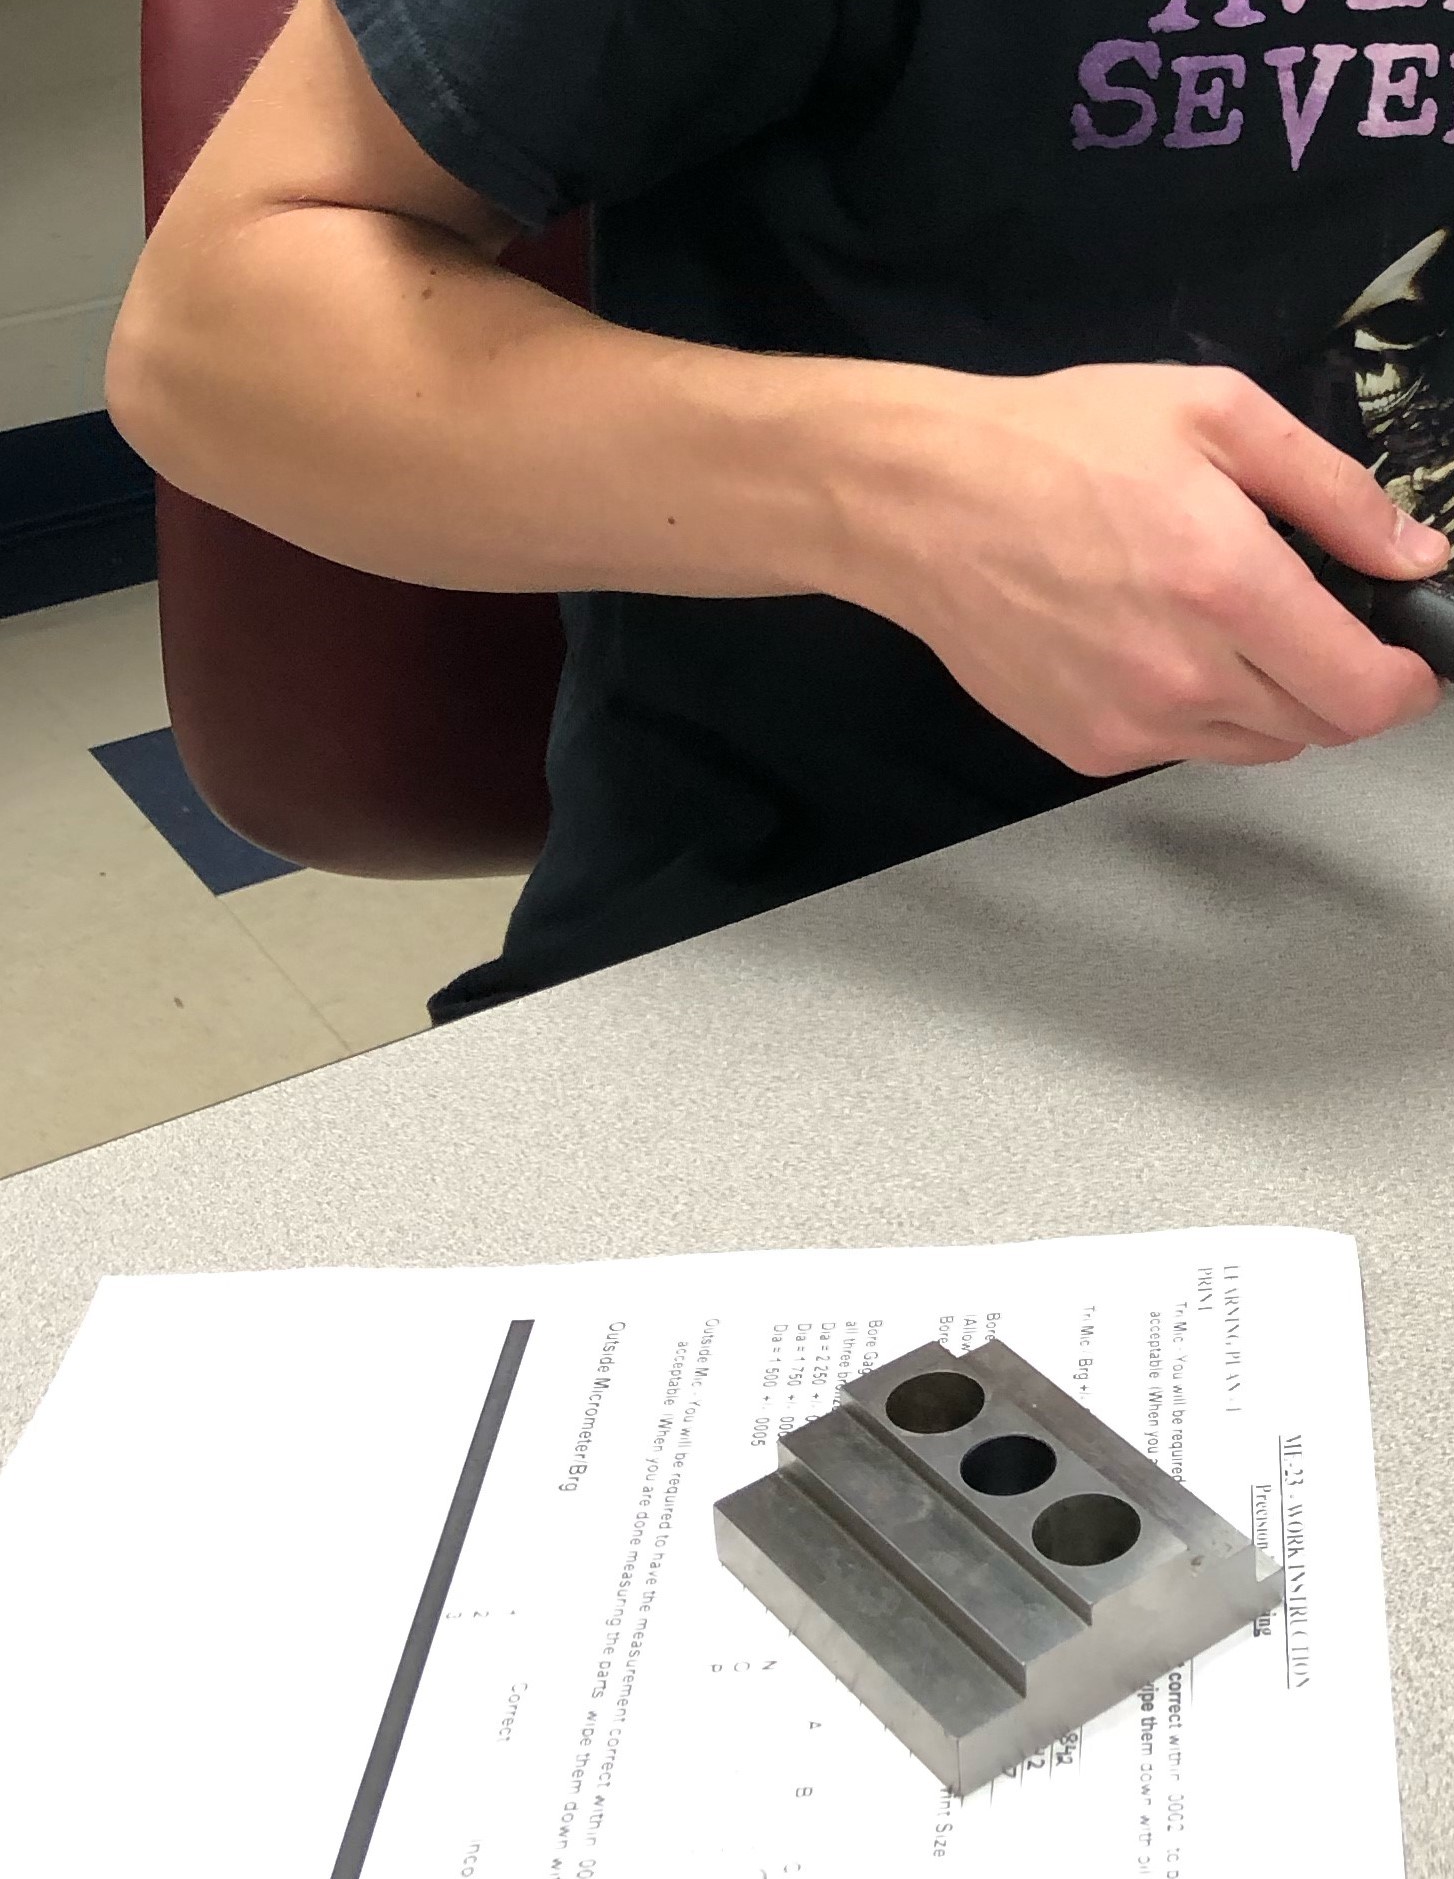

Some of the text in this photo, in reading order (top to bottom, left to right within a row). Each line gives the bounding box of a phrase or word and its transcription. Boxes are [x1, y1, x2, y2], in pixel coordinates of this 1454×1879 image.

[771, 1324, 789, 1343] Dia
[796, 1323, 813, 1342] Dia
[820, 1322, 836, 1341] Dia
[845, 1320, 860, 1334] all
[865, 1320, 883, 1347] Bore
[938, 1316, 954, 1345] Bore
[984, 1312, 1001, 1342] Bore
[696, 1318, 720, 1364] Outside
[838, 1338, 855, 1368] three
[1146, 1311, 1163, 1379] acceptable
[664, 1341, 689, 1406] acceptable
[691, 1367, 710, 1387] Mic
[1072, 1358, 1094, 1380] Brg
[1172, 1355, 1187, 1380] You
[558, 1321, 626, 1492] Outside Micrometer/Brg
[1172, 1384, 1187, 1406] will
[683, 1400, 701, 1423] You
[1171, 1409, 1185, 1425] be
[678, 1427, 692, 1448] will
[1143, 1431, 1159, 1454] you
[673, 1452, 688, 1468] be
[1168, 1428, 1187, 1483] required
[645, 1458, 659, 1481] you
[638, 1485, 654, 1507] are
[659, 1472, 681, 1529] required
[629, 1511, 650, 1546] done
[654, 1534, 670, 1548] to
[646, 1552, 665, 1585] have
[639, 1590, 656, 1612] the
[602, 1631, 620, 1655] the
[612, 1618, 648, 1723] measurement
[498, 1683, 529, 1742] Correct
[1168, 1672, 1183, 1729] correct
[1140, 1716, 1158, 1756] them
[598, 1728, 622, 1788] correct
[571, 1752, 590, 1794] them
[932, 1823, 954, 1858] Size
